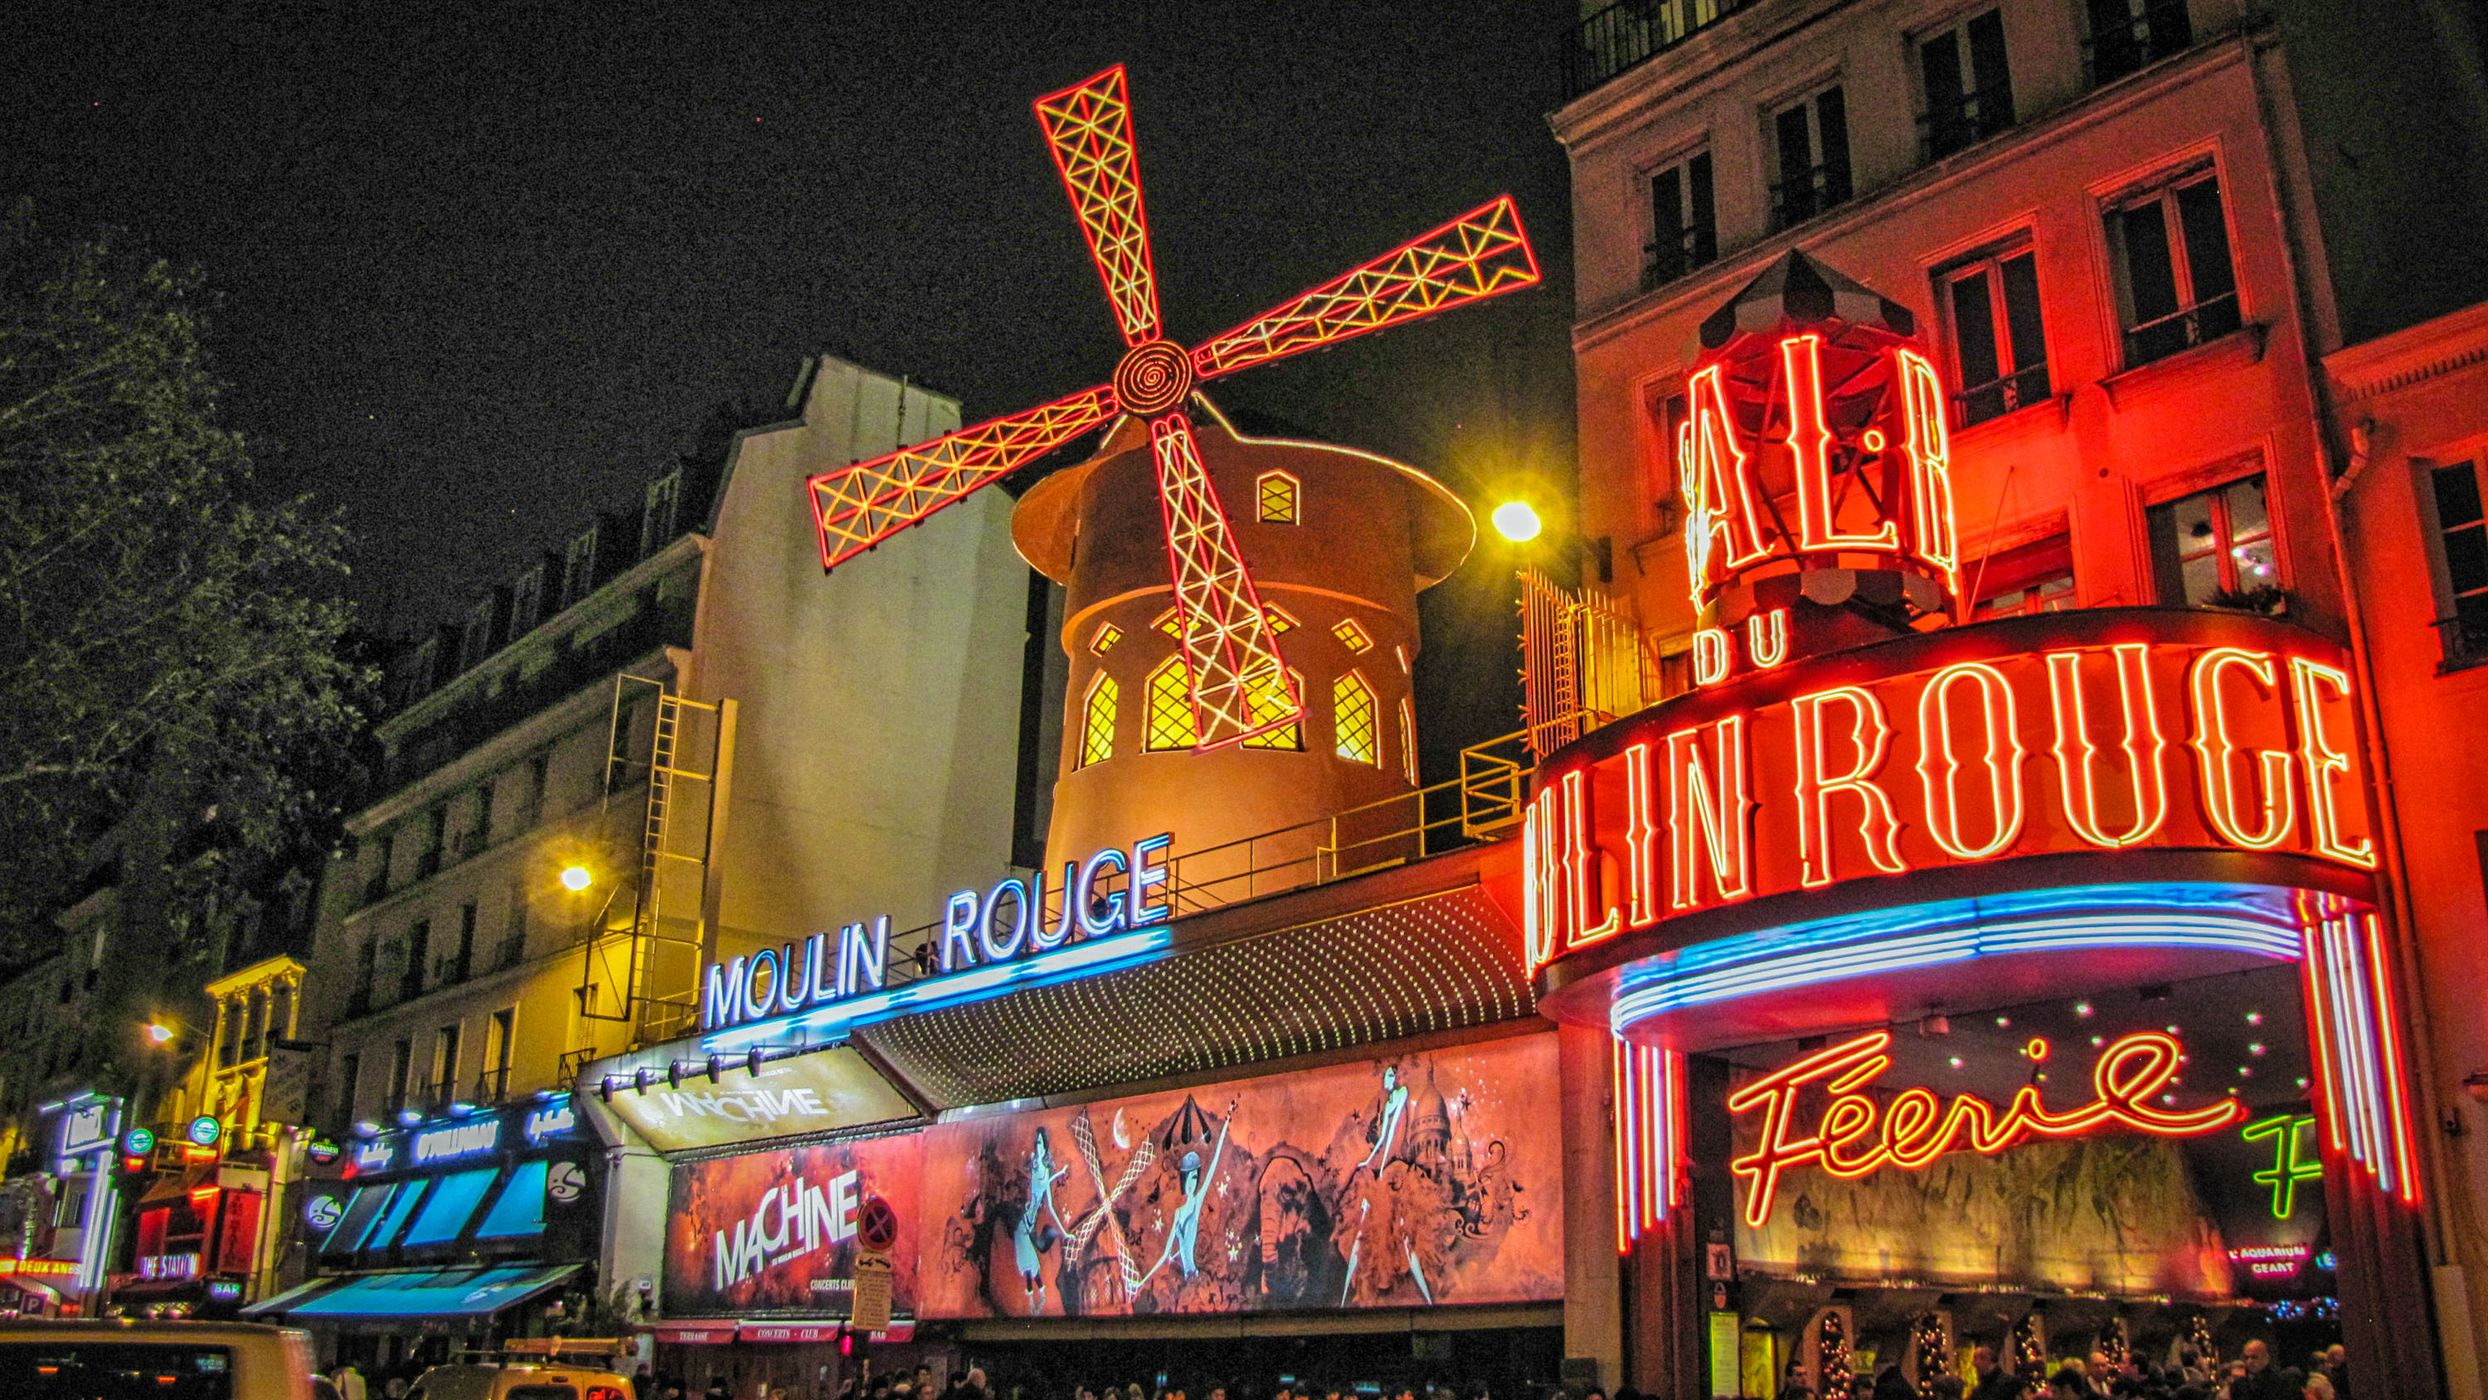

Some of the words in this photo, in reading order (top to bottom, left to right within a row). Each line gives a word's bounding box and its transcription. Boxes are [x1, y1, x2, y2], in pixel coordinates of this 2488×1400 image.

[1692, 609, 1788, 685] DU
[1524, 714, 1750, 979] ULIN
[1792, 643, 2376, 889] ROUGE
[704, 914, 892, 1030] MOULIN
[943, 832, 1176, 973] ROUGE
[1729, 1029, 2238, 1228] Féerie
[161, 1253, 199, 1278] STATION
[714, 1169, 860, 1291] MACHINE
[213, 1283, 241, 1294] BAR
[810, 1278, 840, 1290] CONCERTS
[801, 1328, 819, 1338] CLUB
